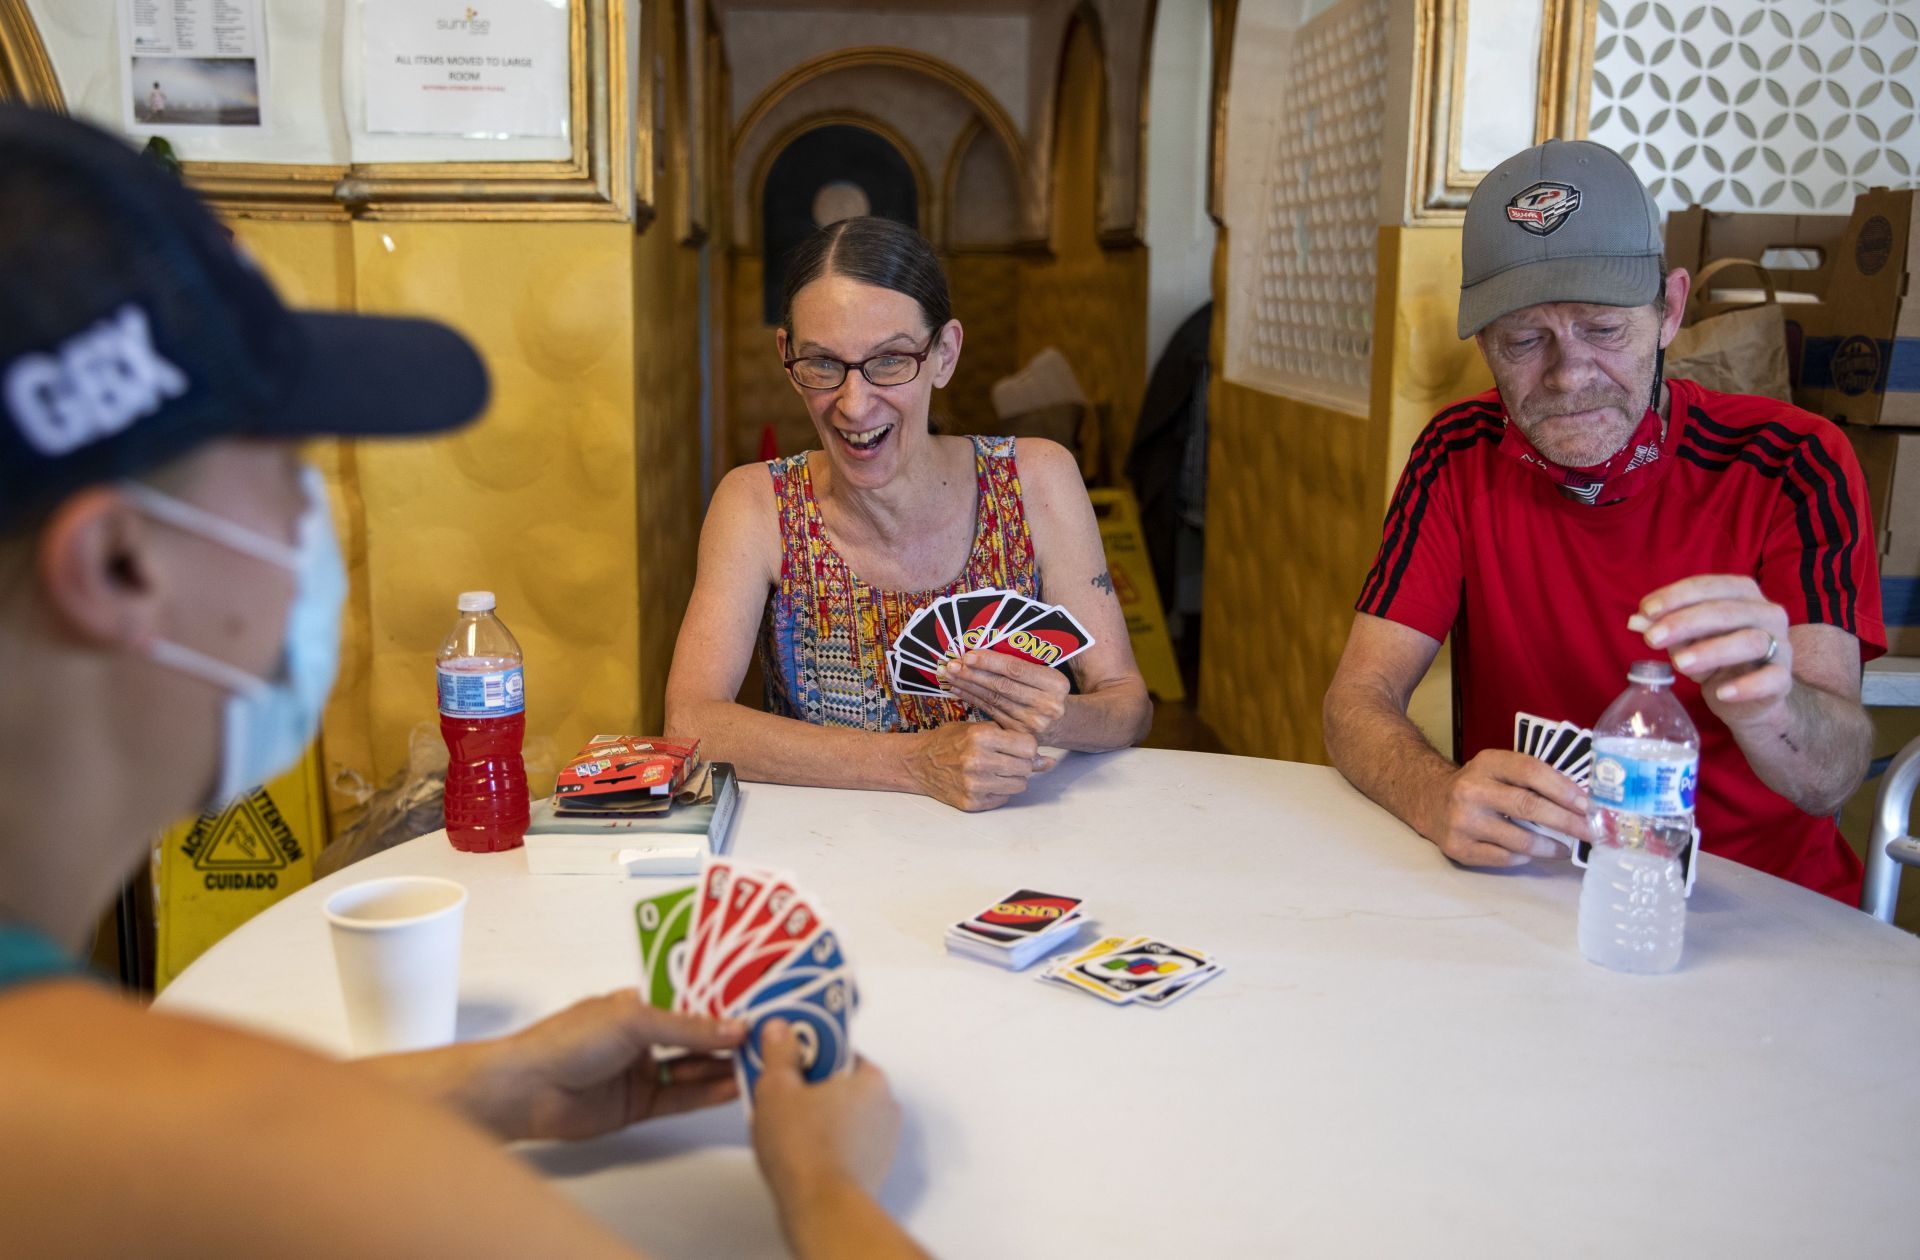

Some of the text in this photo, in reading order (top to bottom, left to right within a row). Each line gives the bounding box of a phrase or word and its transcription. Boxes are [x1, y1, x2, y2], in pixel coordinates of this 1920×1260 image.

[437, 18, 490, 30] sunrise
[395, 56, 532, 68] ALL ITEMS MOVED TO LARGE
[448, 72, 481, 81] ROOM
[1008, 630, 1062, 664] UNO
[205, 873, 278, 890] CUIDADO
[734, 881, 756, 911] 7
[639, 902, 660, 931] 0
[992, 903, 1063, 918] UNO
